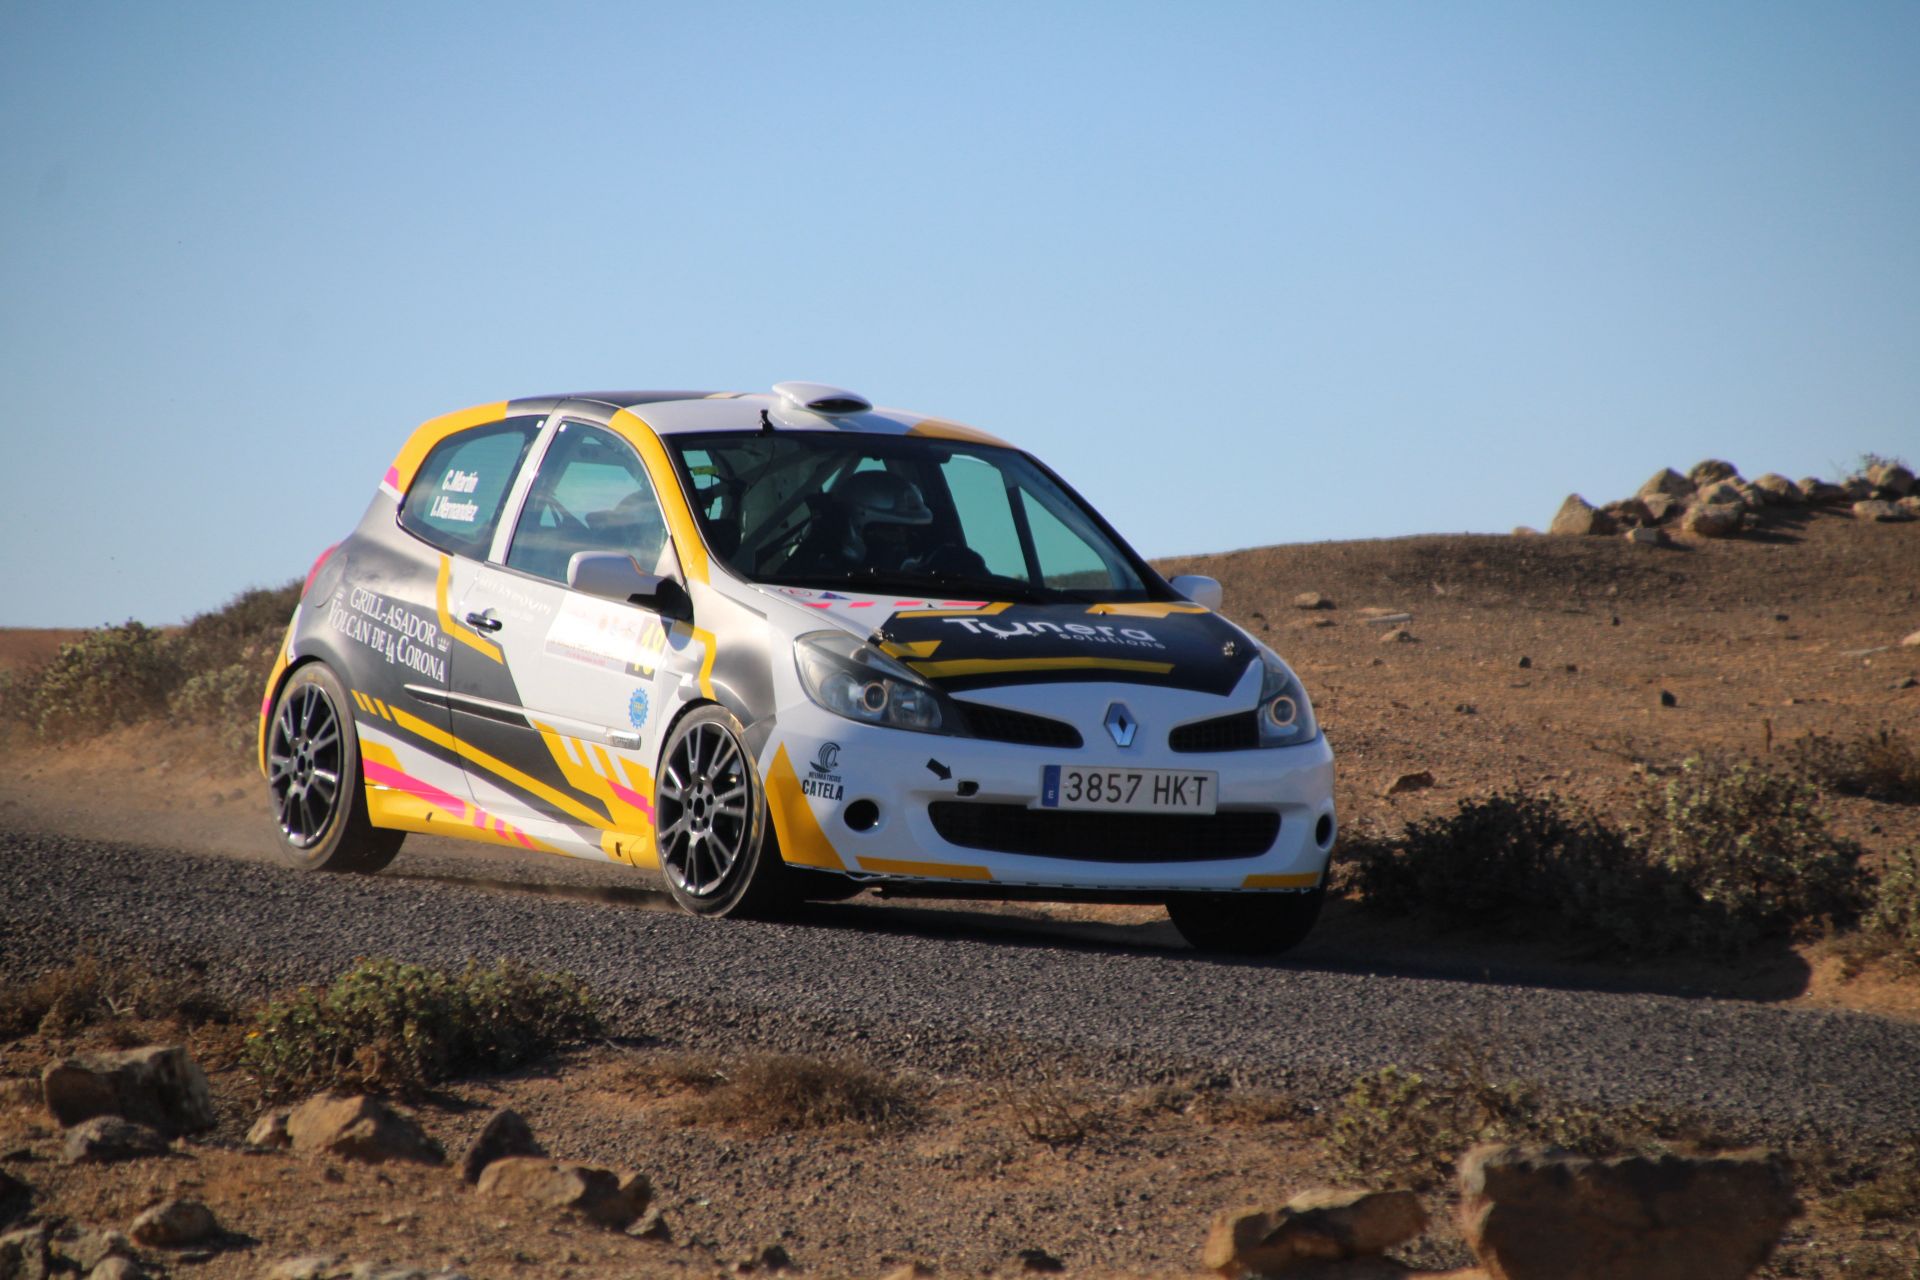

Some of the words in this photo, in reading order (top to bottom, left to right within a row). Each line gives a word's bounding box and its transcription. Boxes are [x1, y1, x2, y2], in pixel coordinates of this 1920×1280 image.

[350, 587, 437, 648] GRILL-ASADOR
[942, 617, 1157, 642] Tunera
[371, 627, 387, 653] DE
[396, 635, 445, 683] CORONA
[802, 779, 844, 801] CATELA
[1066, 772, 1143, 804] 3857
[1153, 775, 1208, 806] HKT
